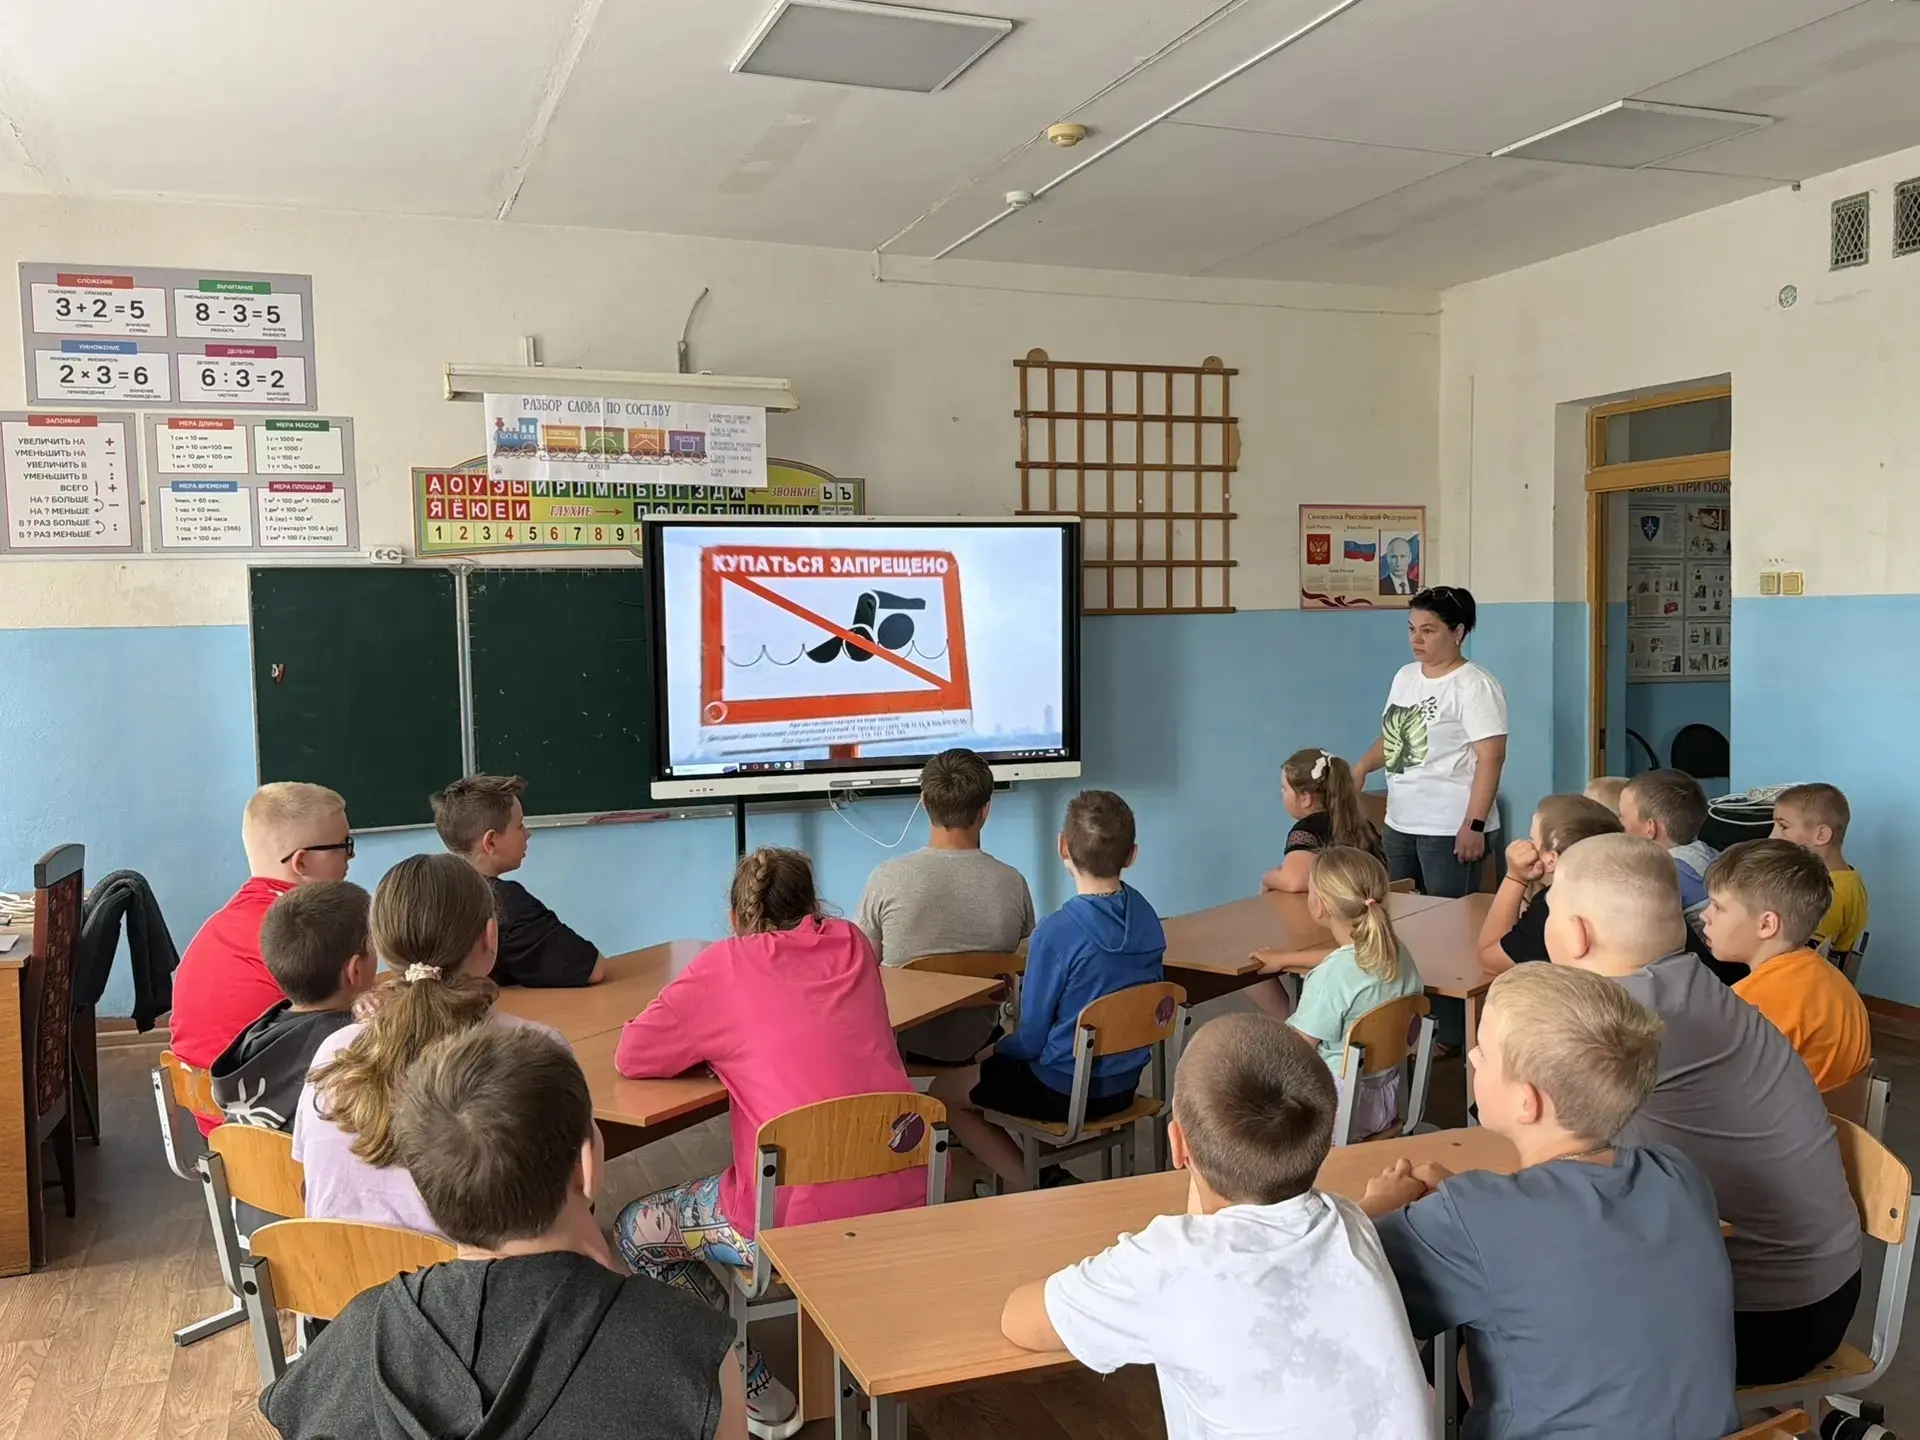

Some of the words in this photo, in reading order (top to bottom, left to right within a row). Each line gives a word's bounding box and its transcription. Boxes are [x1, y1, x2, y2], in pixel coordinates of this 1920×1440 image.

[56, 298, 71, 316] 3
[93, 299, 107, 317] 2
[130, 300, 145, 319] 5
[196, 303, 210, 321] 8
[233, 304, 247, 322] 3
[267, 306, 280, 323] 5
[60, 365, 74, 383] 2
[97, 366, 111, 384] 3
[134, 367, 148, 385] 6
[202, 368, 215, 386] 6
[236, 369, 250, 387] 3
[271, 370, 284, 388] 2
[523, 398, 562, 411] РАЗБОР
[568, 400, 600, 413] СЛОВА
[607, 402, 620, 414] ПО
[626, 403, 671, 416] СОСТАВУ
[429, 477, 441, 492] А
[450, 477, 463, 492] О
[472, 478, 483, 493] У
[494, 480, 504, 493] Э
[513, 481, 527, 493] Ы
[556, 482, 566, 494] Р
[576, 482, 587, 495] Л
[595, 483, 608, 496] М
[616, 484, 627, 496] Н
[636, 484, 647, 497] Б
[656, 484, 666, 497] В
[695, 485, 704, 497] З
[731, 488, 744, 498] Ж
[771, 487, 816, 497] ЗВОНКИЕ
[824, 486, 832, 499] Ь
[840, 487, 851, 500] Ъ
[1678, 482, 1700, 492] ПРИ
[430, 502, 441, 516] Я
[453, 497, 464, 517] Ё
[471, 502, 488, 517] Ю
[495, 503, 506, 517] Е
[516, 504, 527, 518] И
[551, 506, 592, 516] ГЛУХИЕ
[637, 505, 647, 519] П
[1383, 514, 1417, 523] Федерации
[435, 526, 442, 540] 1
[459, 526, 468, 540] 2
[483, 526, 491, 540] 3
[505, 527, 513, 540] 4
[529, 527, 537, 540] 5
[550, 527, 558, 540] 6
[574, 527, 581, 541] 7
[594, 527, 602, 541] 8
[617, 527, 624, 541] 9
[634, 528, 640, 541] 1
[712, 554, 823, 573] КУПАТЬСЯ
[830, 556, 948, 576] ЗАПРЕЩЕНО
